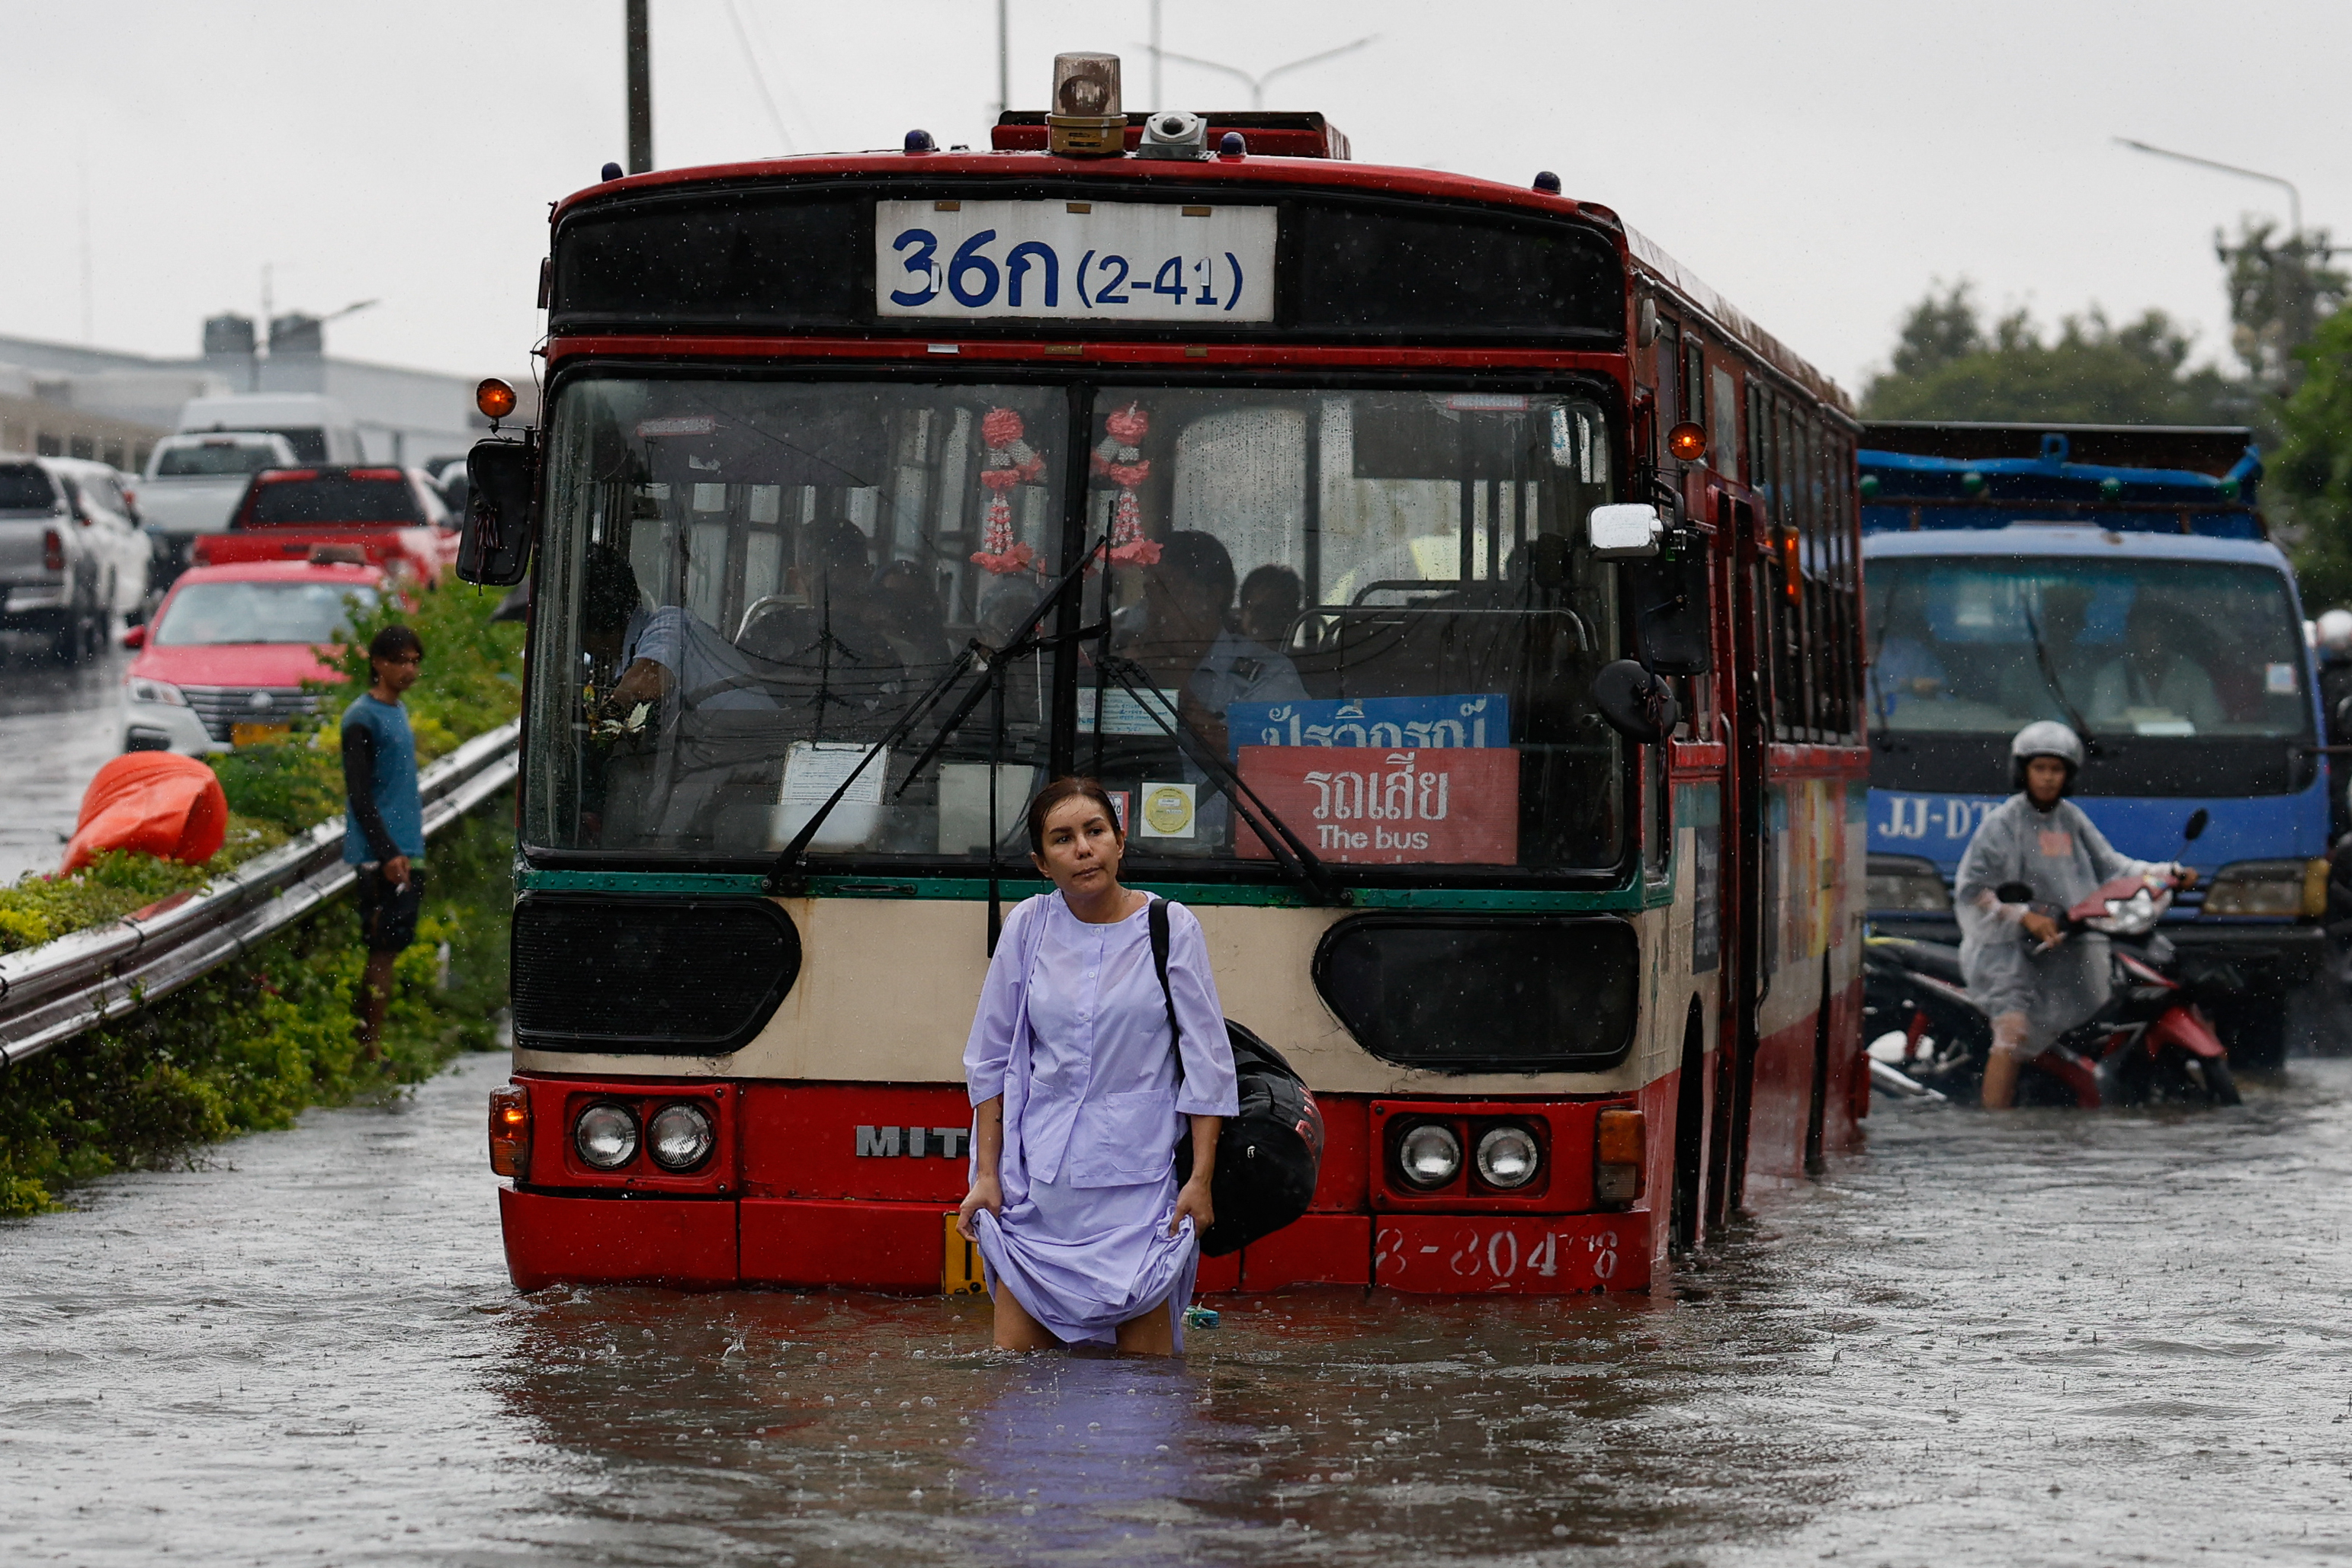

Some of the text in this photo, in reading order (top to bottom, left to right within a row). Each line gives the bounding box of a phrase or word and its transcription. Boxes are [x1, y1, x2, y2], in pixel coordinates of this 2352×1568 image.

[890, 229, 1243, 311] 36ก (2-41)
[1304, 752, 1448, 820] รถเสีย
[1317, 824, 1429, 850] The bus
